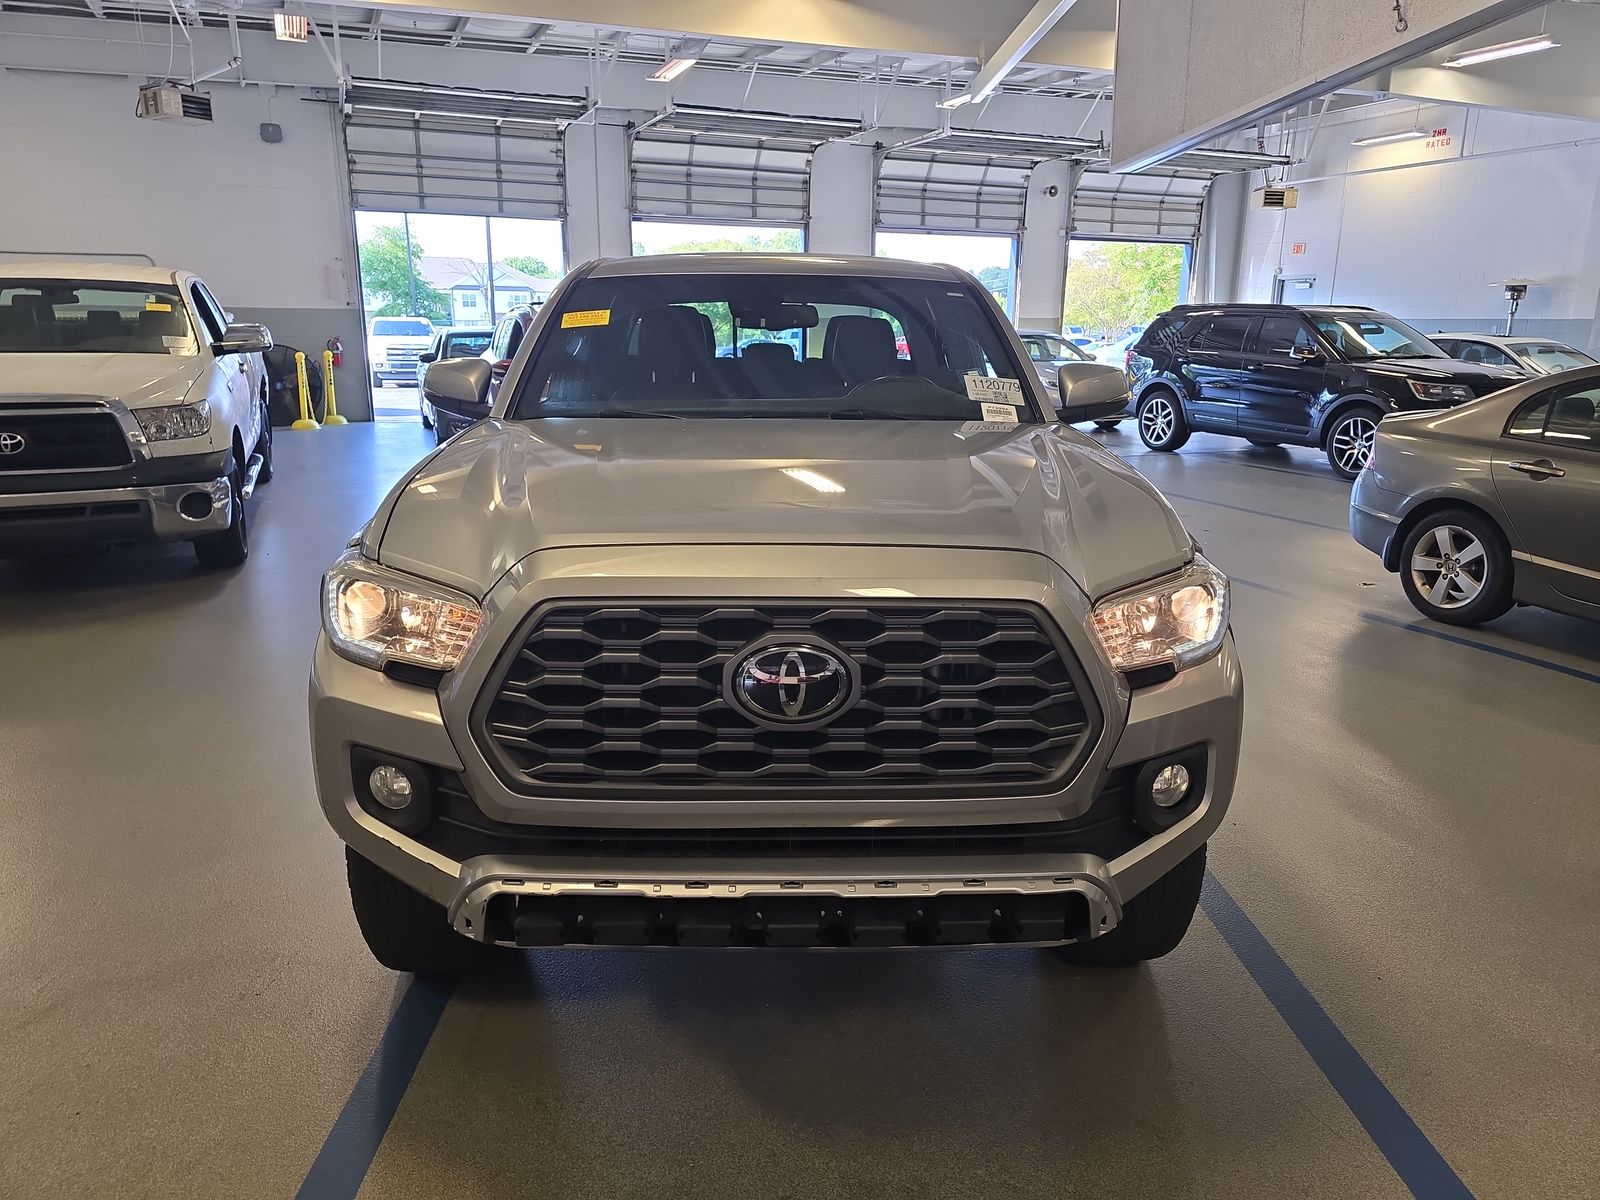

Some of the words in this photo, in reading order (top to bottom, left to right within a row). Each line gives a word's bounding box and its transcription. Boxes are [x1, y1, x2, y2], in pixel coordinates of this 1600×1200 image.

[1432, 128, 1447, 137] 2HR
[1426, 138, 1451, 149] RATED
[1293, 244, 1303, 254] EXIT
[972, 379, 1020, 392] 1120779
